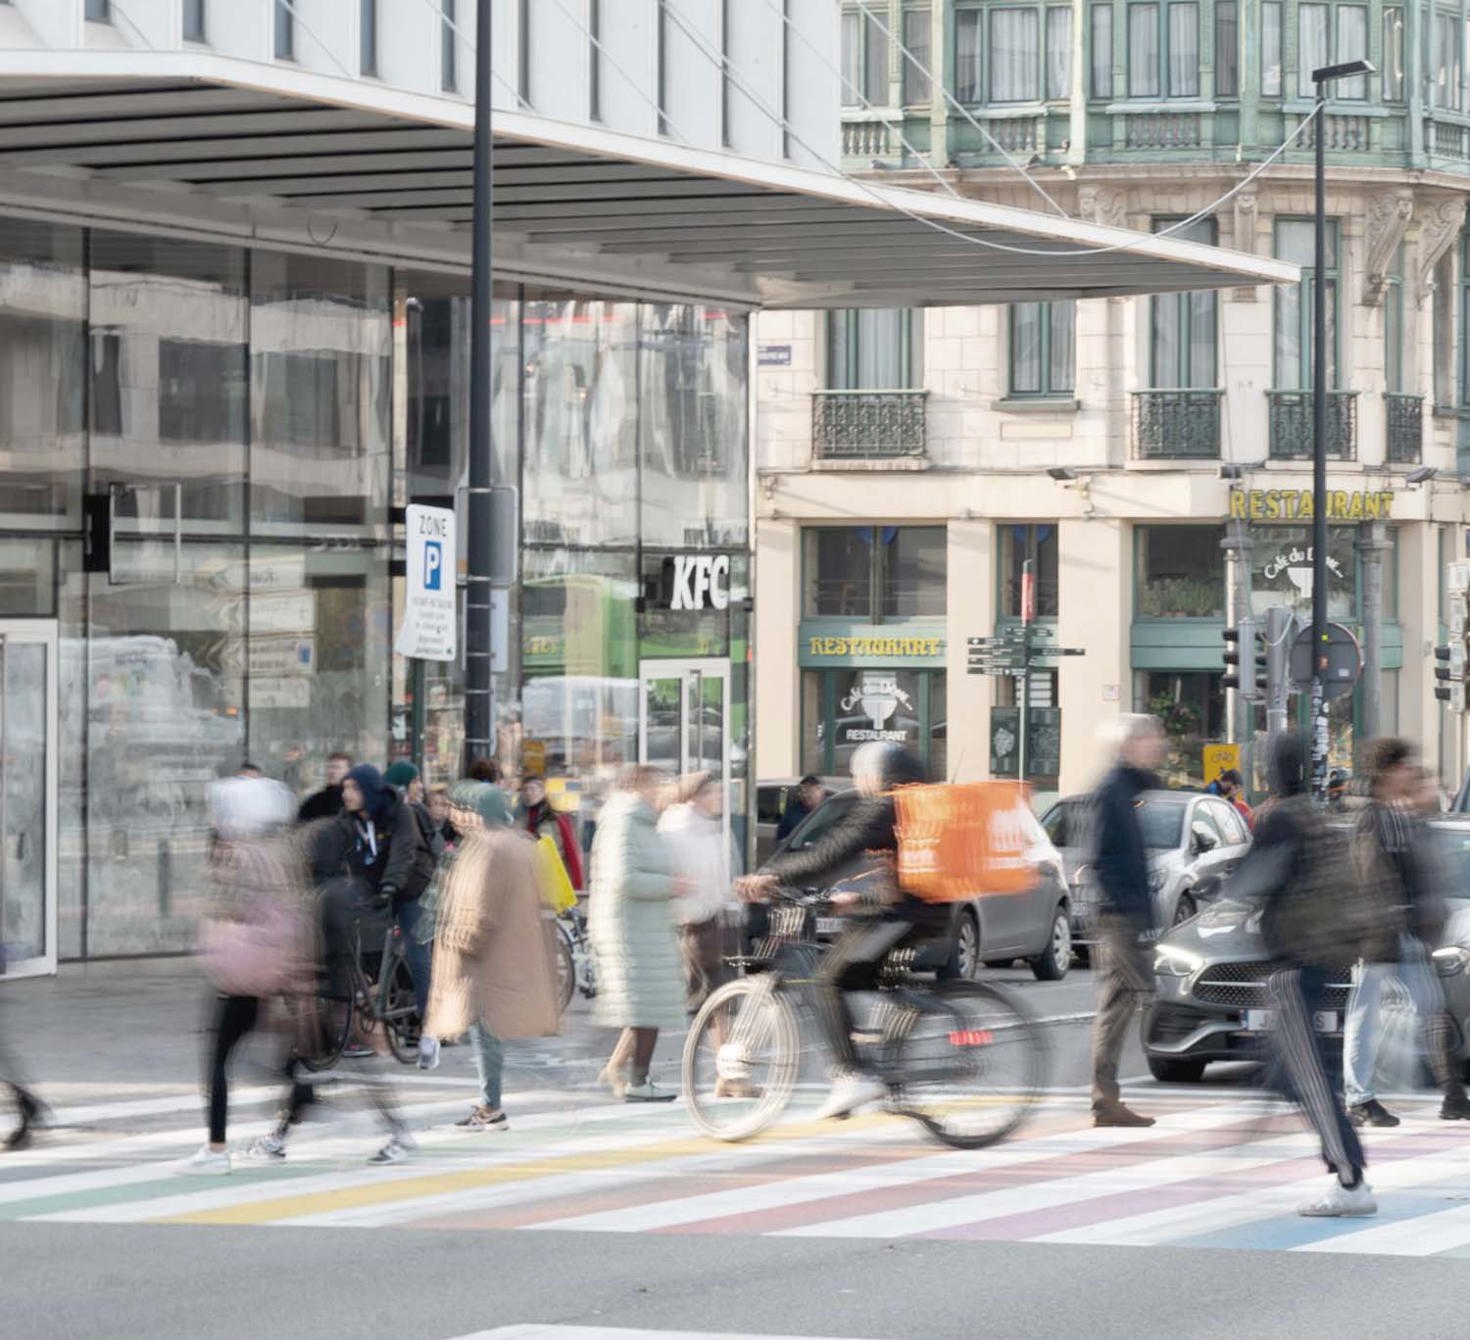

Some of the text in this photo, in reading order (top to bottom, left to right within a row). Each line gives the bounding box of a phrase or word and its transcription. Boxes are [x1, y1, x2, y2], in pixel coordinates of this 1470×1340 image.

[419, 515, 447, 537] ZONE
[425, 546, 440, 585] P
[670, 554, 730, 610] KFC
[810, 637, 939, 656] RESTAURANT
[846, 729, 908, 741] RESTAURANT
